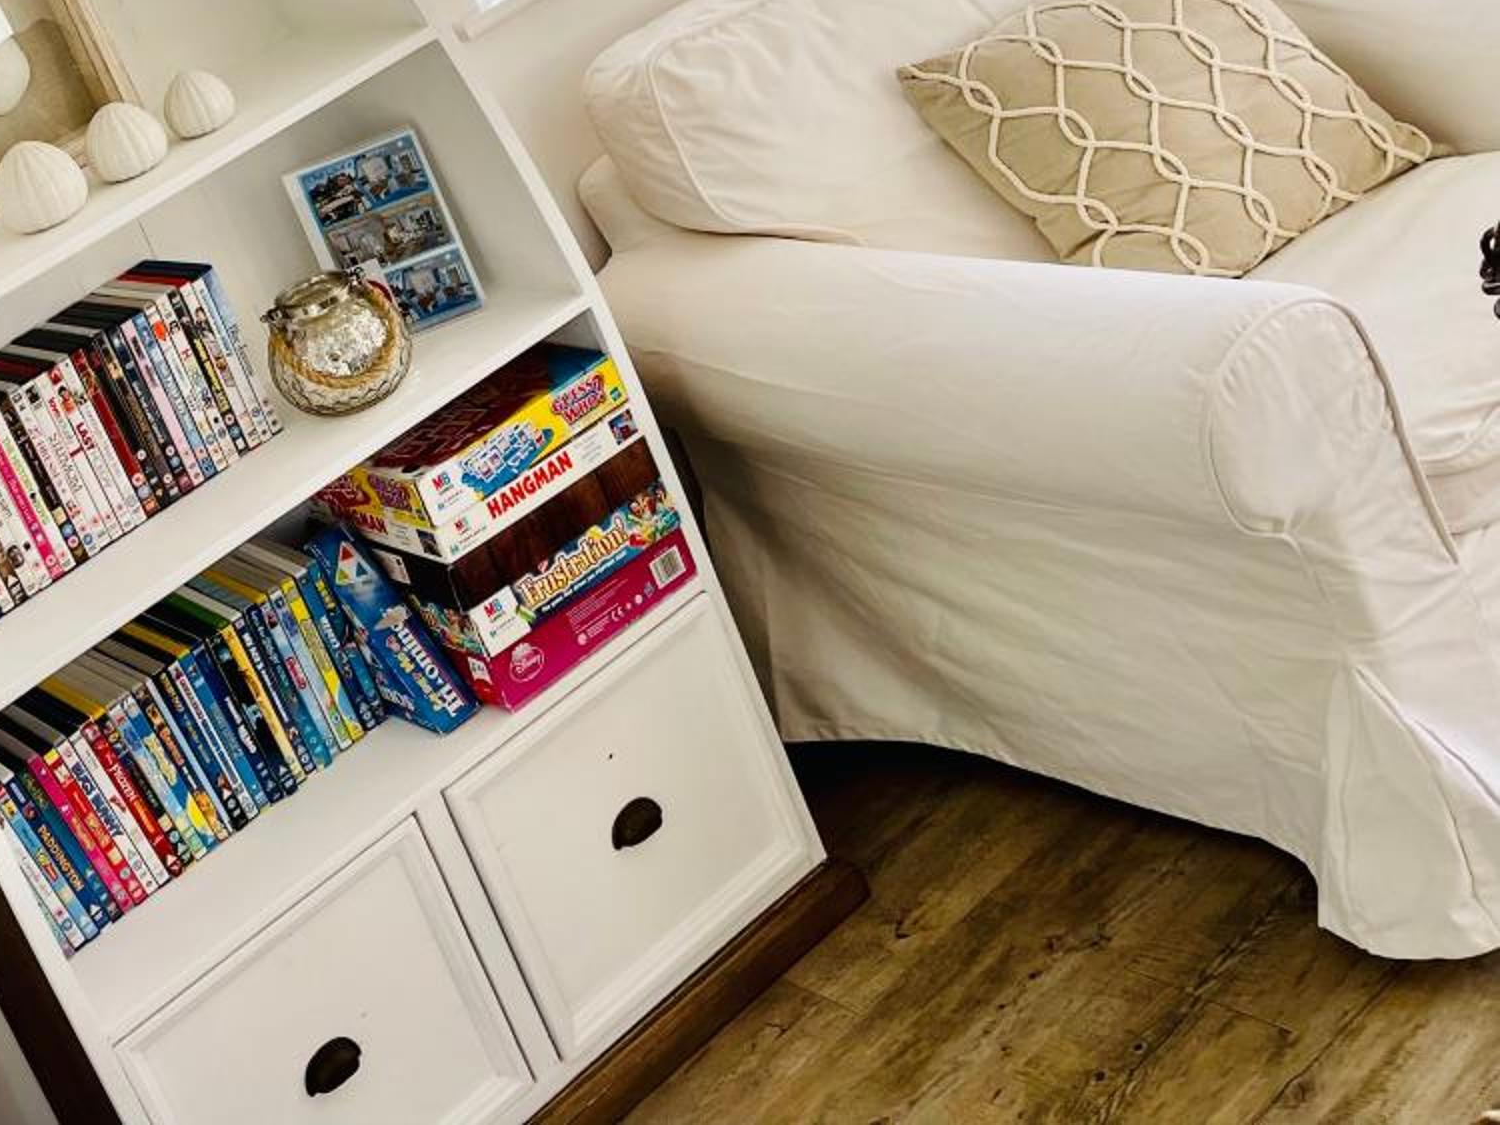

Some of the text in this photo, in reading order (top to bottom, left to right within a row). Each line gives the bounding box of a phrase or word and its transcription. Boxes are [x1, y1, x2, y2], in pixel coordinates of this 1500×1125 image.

[431, 470, 451, 491] MB
[486, 451, 573, 519] HANGMAN
[516, 515, 628, 609] Frustration!
[483, 598, 504, 619] MB
[37, 824, 85, 892] PADDINGTON
